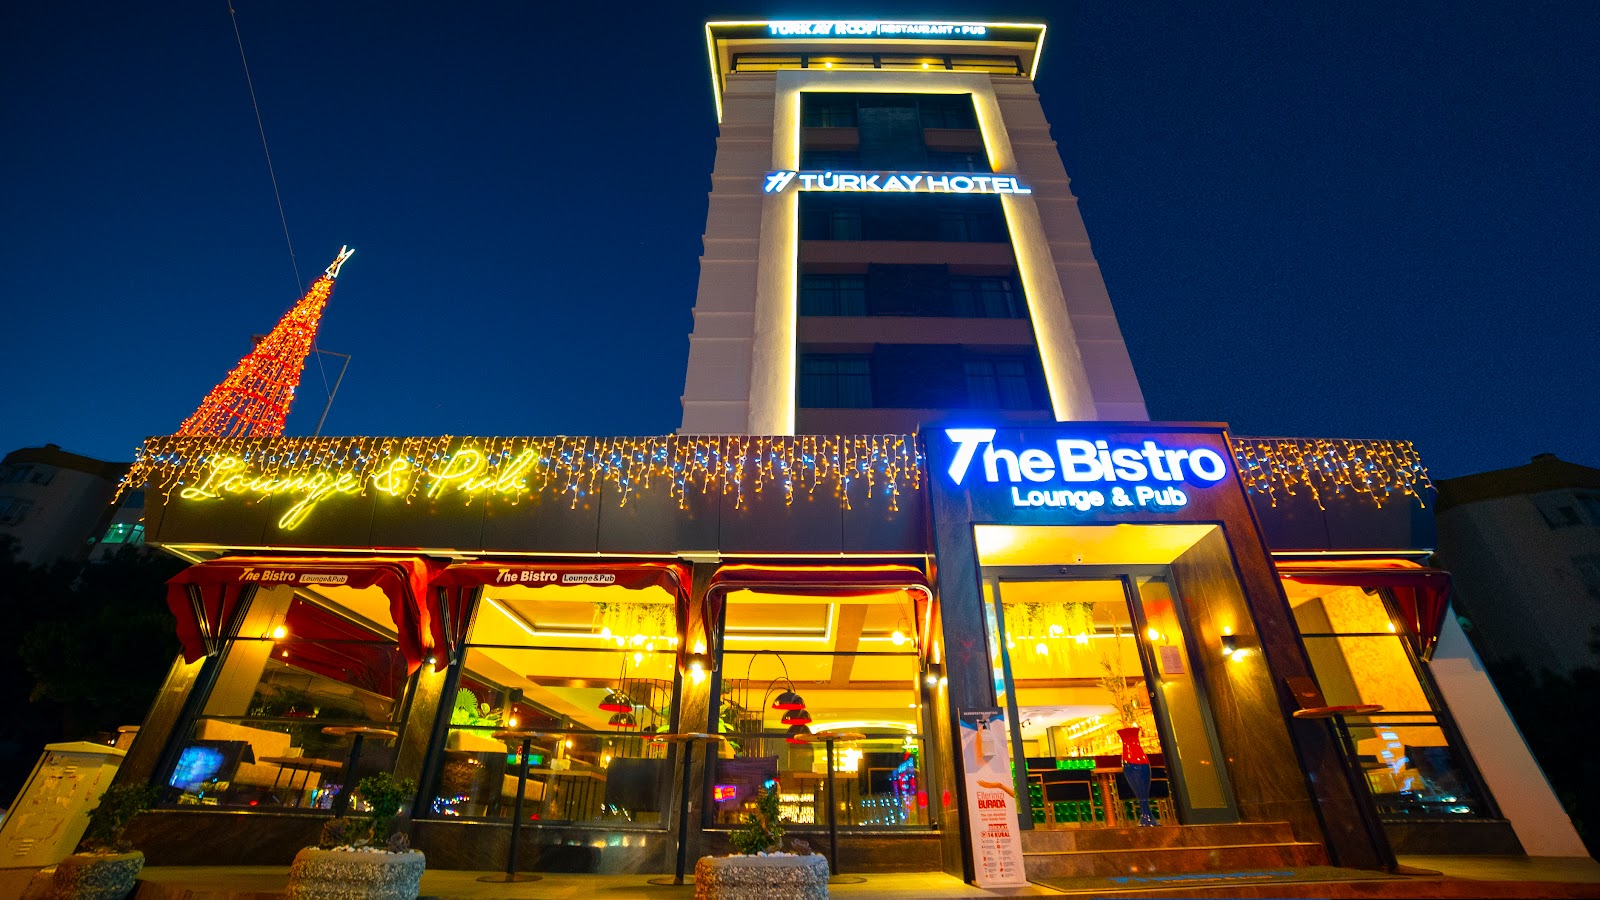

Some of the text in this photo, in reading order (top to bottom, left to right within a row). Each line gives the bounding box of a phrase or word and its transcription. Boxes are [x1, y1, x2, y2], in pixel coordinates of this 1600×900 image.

[835, 22, 877, 35] ROOF
[881, 24, 985, 35] RESTAURANT PUB
[926, 175, 1031, 194] HOTEL
[945, 428, 1227, 486] The Bistro
[181, 449, 535, 530] Lounge & Pub
[1011, 486, 1188, 512] Lounge & Pub
[239, 568, 296, 582] The Bistro
[496, 568, 558, 583] The Bistro
[978, 800, 1006, 808] BURADA
